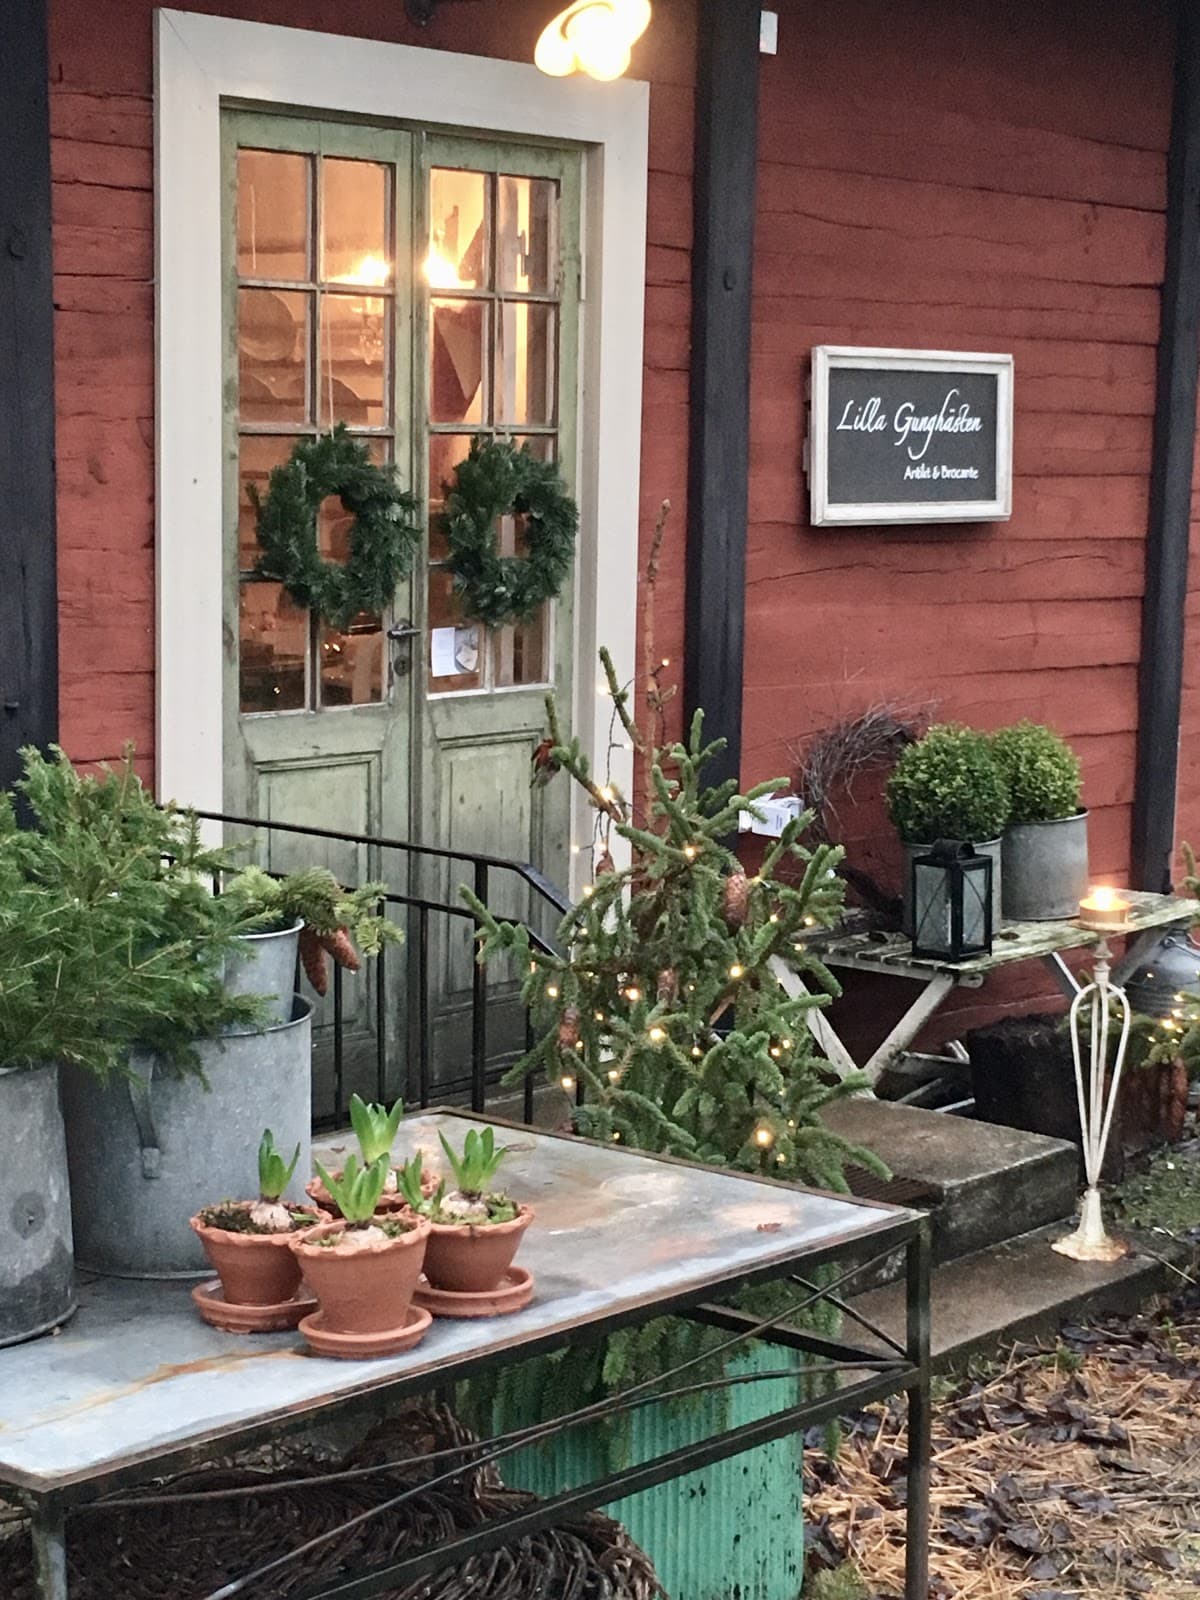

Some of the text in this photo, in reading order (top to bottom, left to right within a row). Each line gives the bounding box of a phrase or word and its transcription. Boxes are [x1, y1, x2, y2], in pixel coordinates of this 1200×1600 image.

[836, 389, 983, 460] Lilla Gunghästen
[932, 465, 940, 480] &
[941, 464, 979, 480] Brocante
